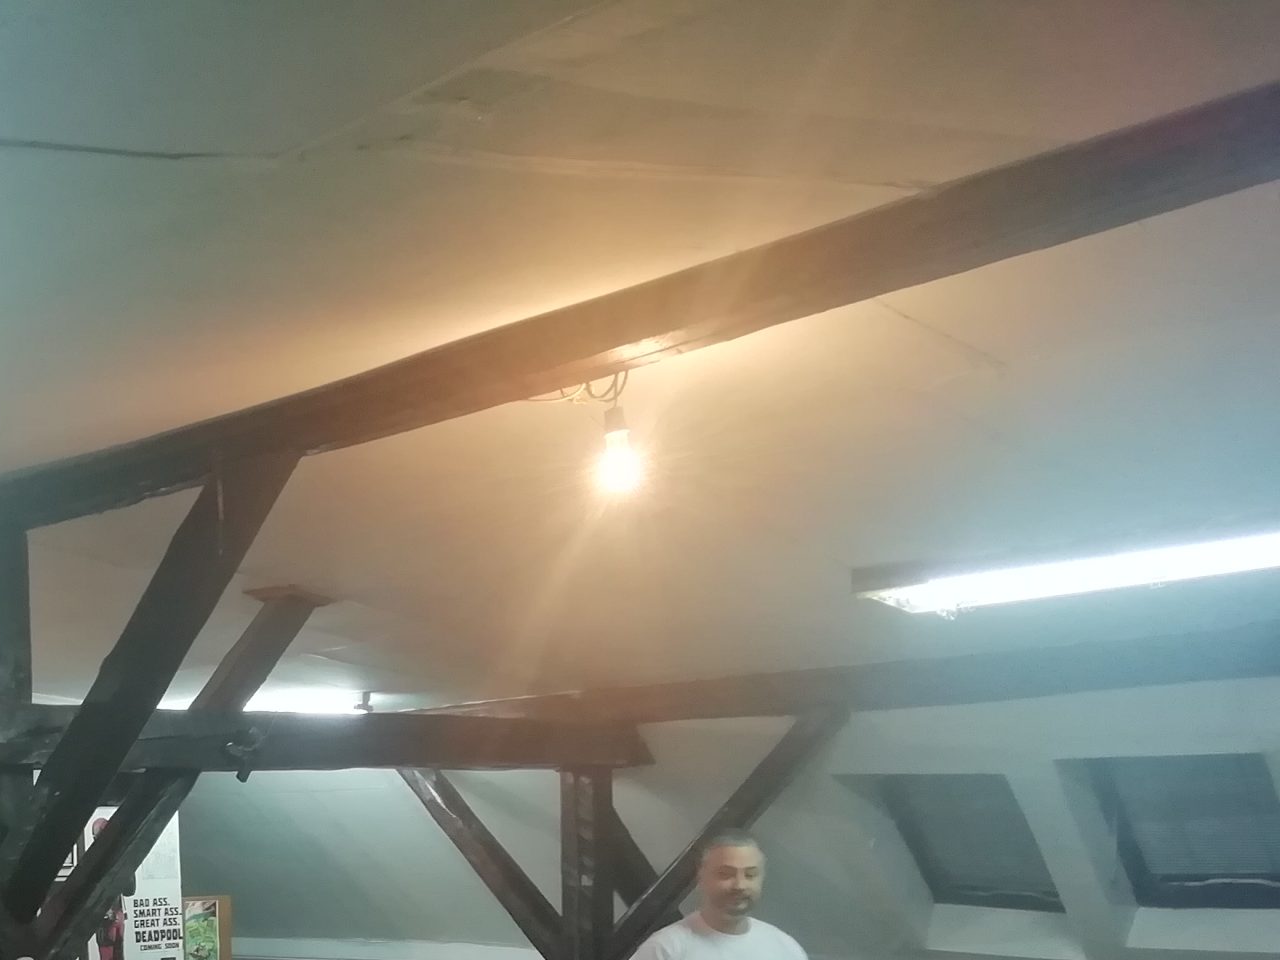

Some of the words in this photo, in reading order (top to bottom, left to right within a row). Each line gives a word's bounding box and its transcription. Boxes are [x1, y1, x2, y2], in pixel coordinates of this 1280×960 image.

[133, 898, 149, 908] BAD
[152, 897, 170, 907] ASS.
[133, 908, 161, 918] SMART
[164, 907, 182, 916] ASS.
[134, 918, 160, 928] GREAT
[162, 917, 180, 927] ASS.
[135, 928, 183, 943] DEADPOOL
